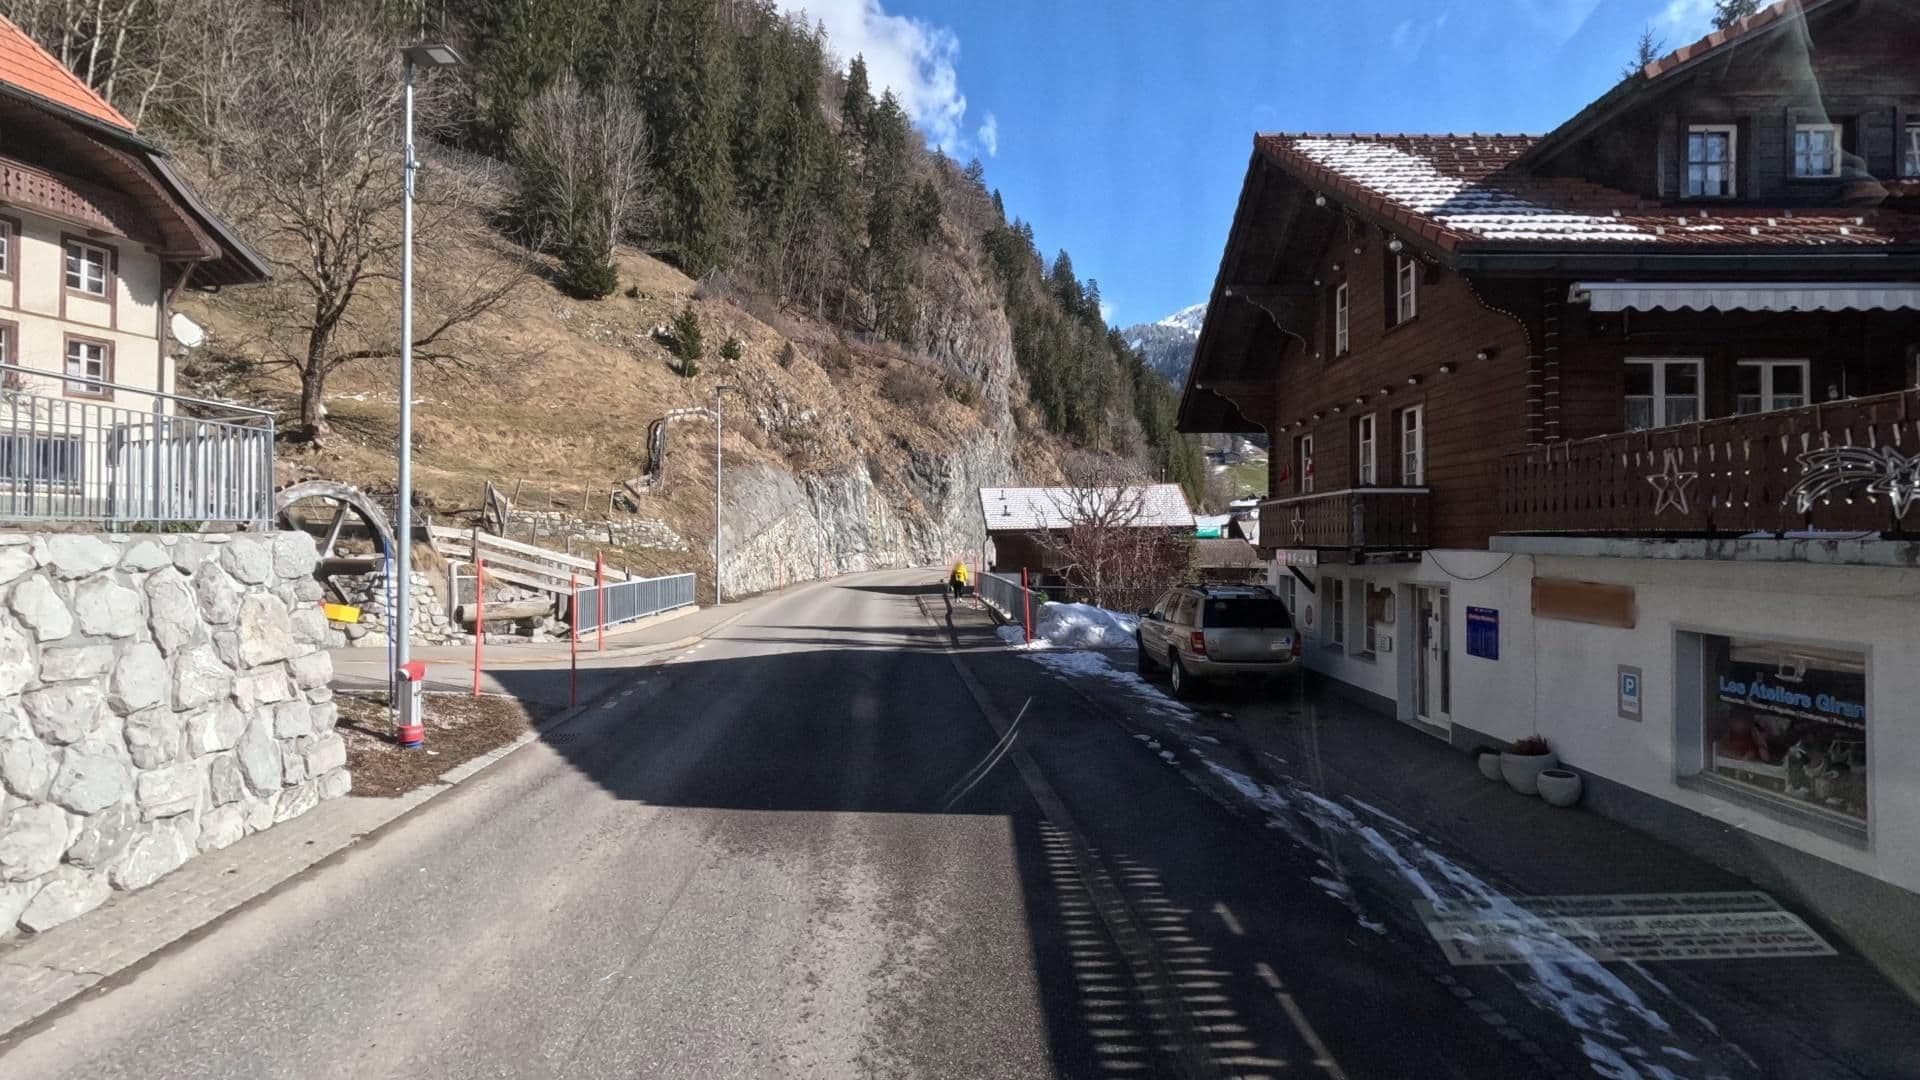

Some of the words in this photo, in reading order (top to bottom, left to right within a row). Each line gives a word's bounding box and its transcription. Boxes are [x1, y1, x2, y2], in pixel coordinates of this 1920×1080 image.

[1626, 678, 1634, 693] P
[1719, 675, 1746, 695] Les
[1749, 681, 1811, 708] Ateliers
